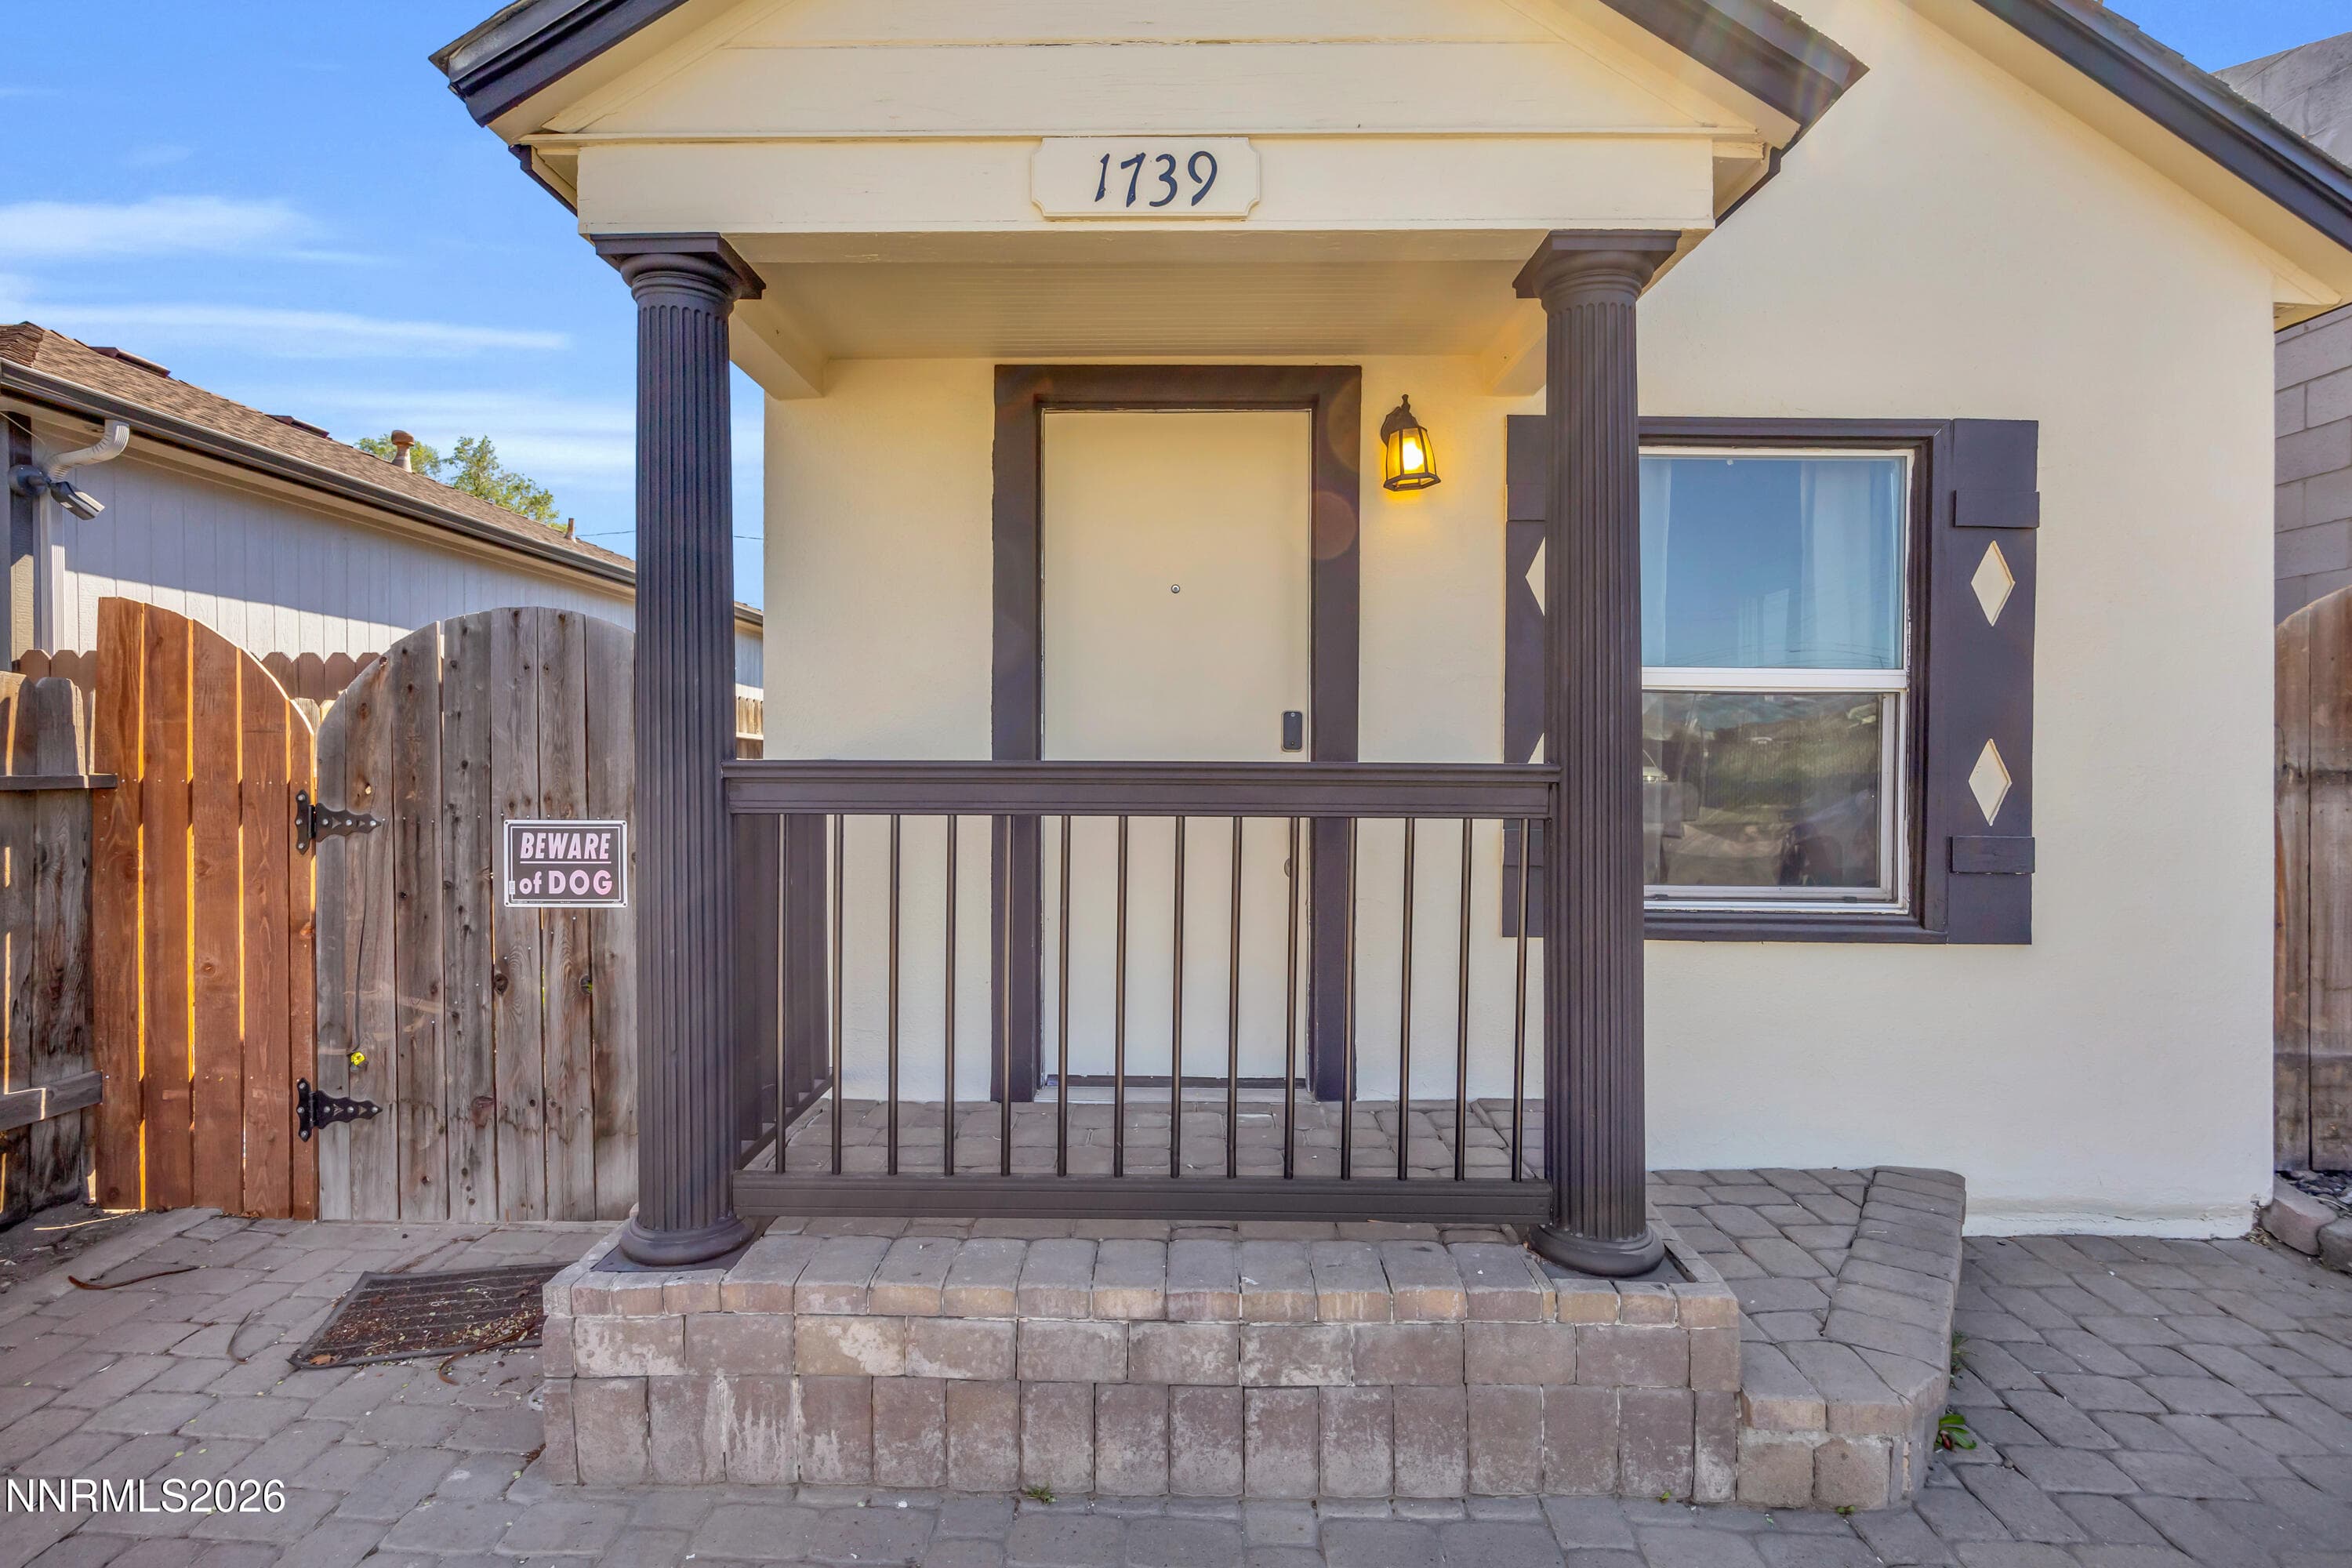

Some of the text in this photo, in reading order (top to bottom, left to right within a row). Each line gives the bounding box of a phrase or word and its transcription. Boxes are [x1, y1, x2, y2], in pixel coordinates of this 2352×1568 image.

[1094, 151, 1218, 208] 1739
[520, 832, 611, 859] BEWARE
[519, 871, 543, 895] of
[548, 869, 613, 895] DOG
